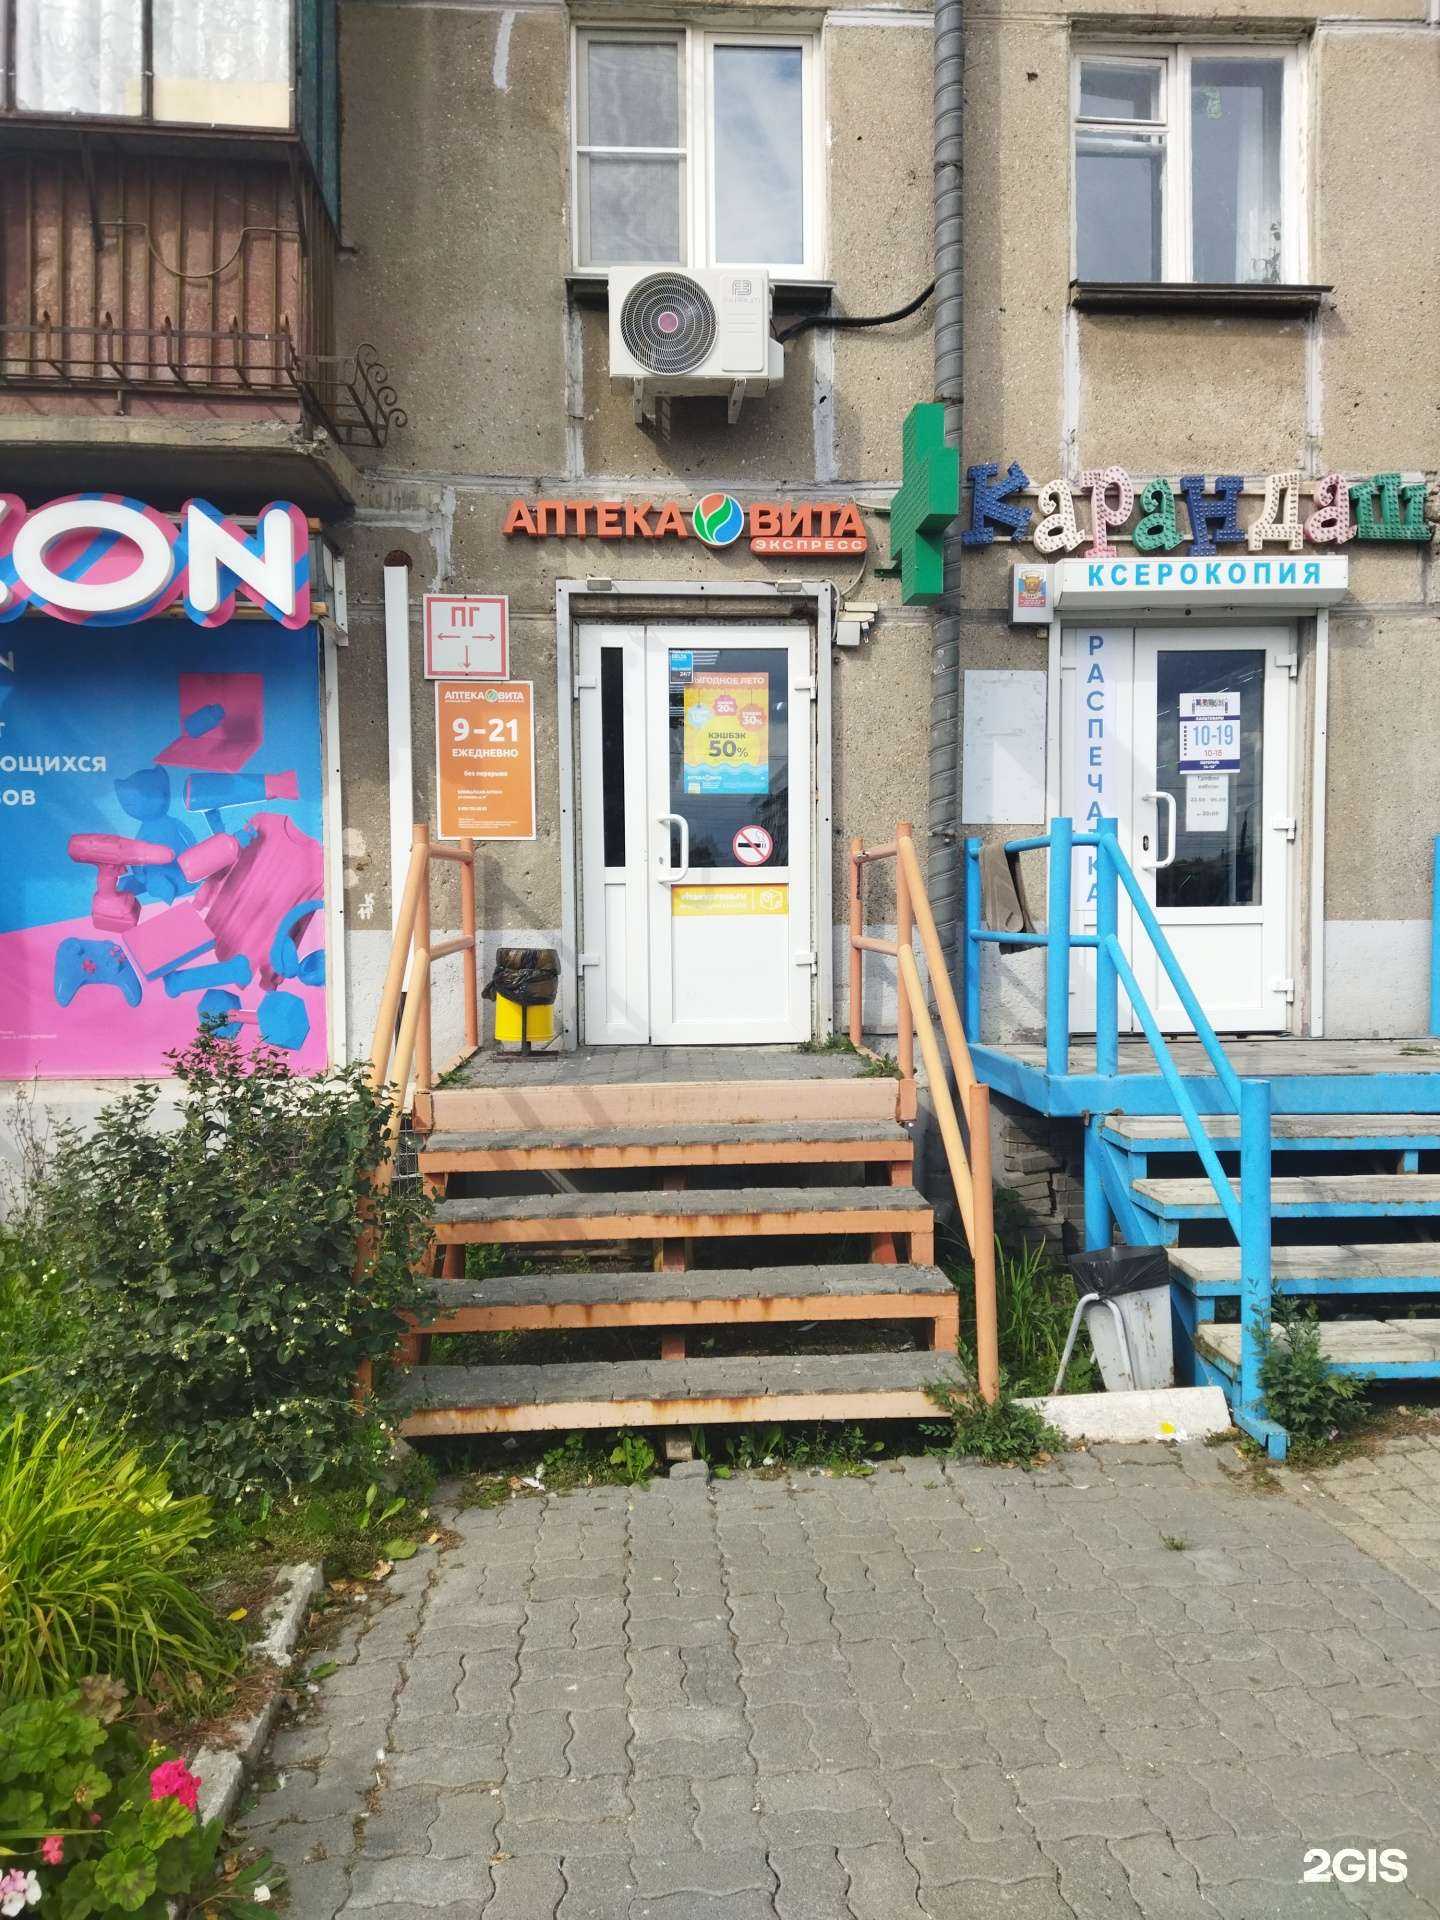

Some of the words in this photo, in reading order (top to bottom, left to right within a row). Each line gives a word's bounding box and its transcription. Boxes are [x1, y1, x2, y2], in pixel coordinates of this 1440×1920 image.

[503, 500, 689, 540] АПТЕКА
[749, 502, 866, 538] ВИТА
[754, 540, 865, 552] ЭКСПРЕСС
[0, 499, 296, 616] ON
[1088, 562, 1322, 587] КСЕРОКОПИЯ
[451, 606, 480, 627] ПГ
[444, 691, 484, 700] АПТЕКА
[498, 692, 525, 700] ВИТА
[1193, 725, 1233, 746] 10-19
[452, 748, 519, 758] ЕЖЕДНЕВНО
[708, 740, 749, 758] 50%
